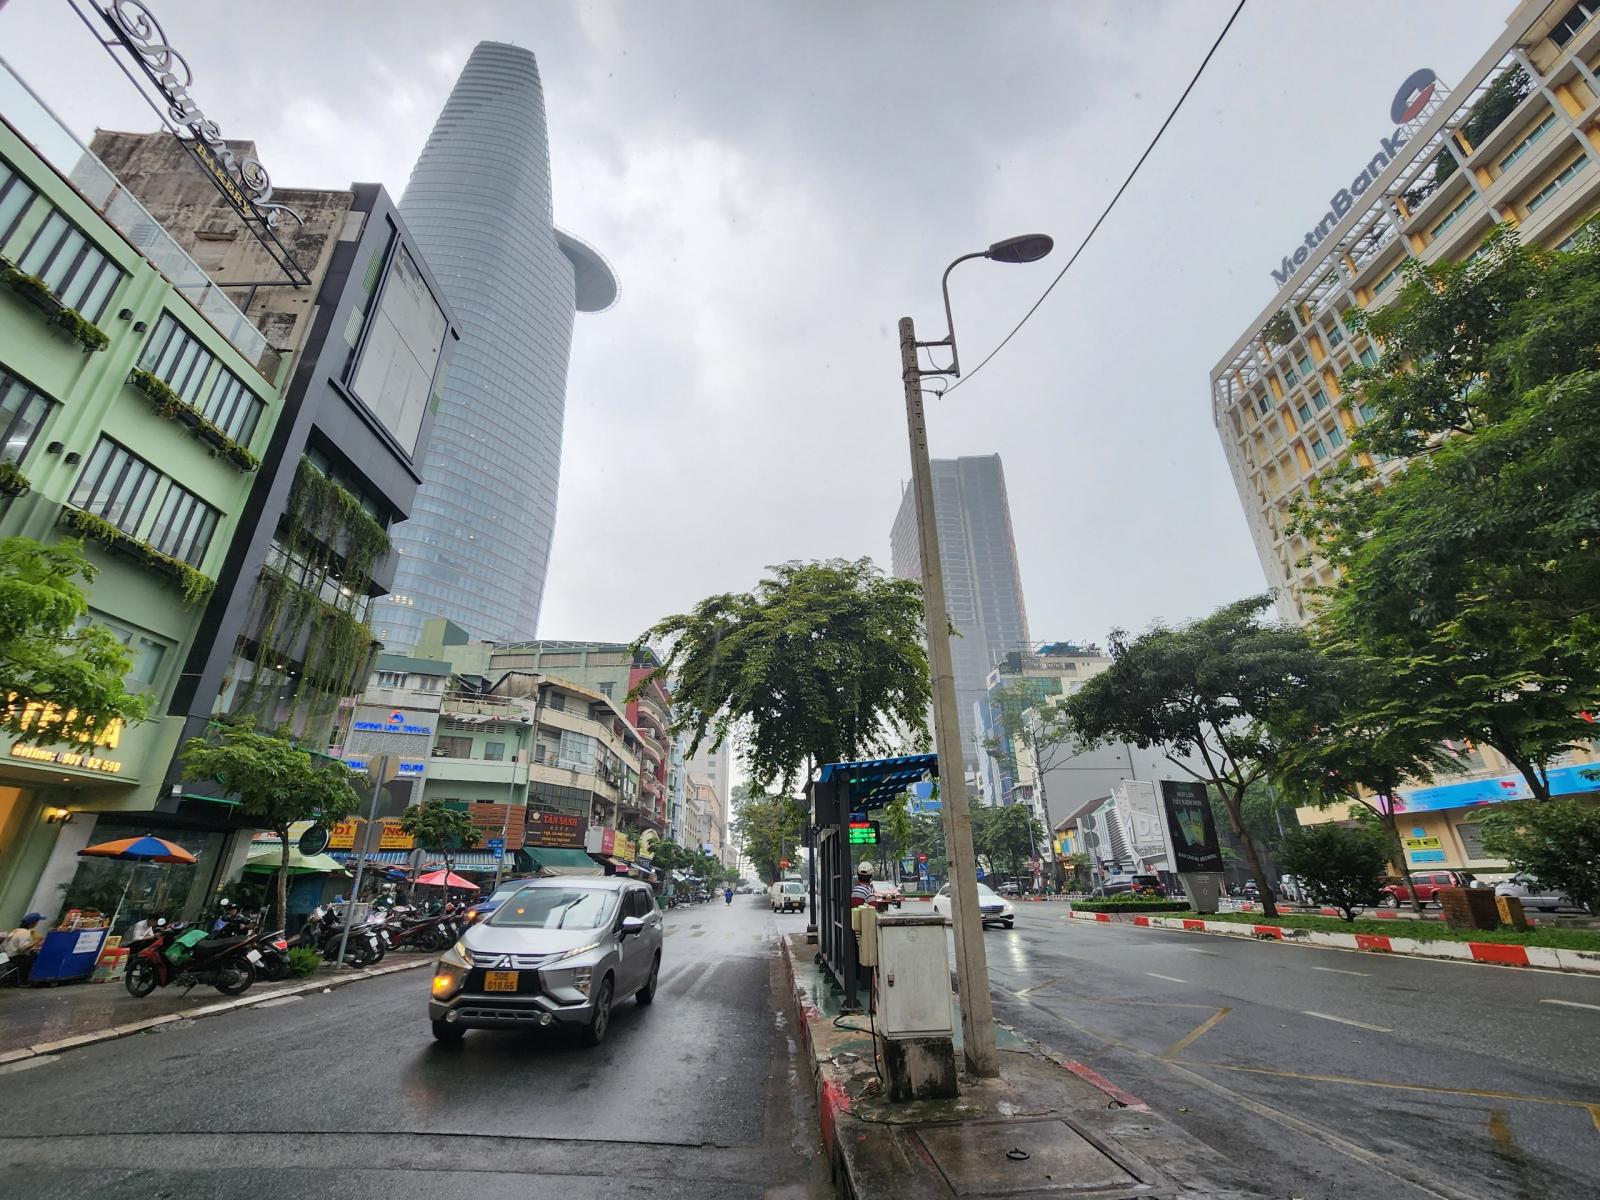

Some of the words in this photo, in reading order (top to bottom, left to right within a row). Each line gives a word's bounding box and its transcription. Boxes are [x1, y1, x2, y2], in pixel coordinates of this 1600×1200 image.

[196, 142, 252, 215] BAKERY
[1270, 127, 1409, 284] VietinBank
[56, 752, 82, 767] 0901
[82, 757, 101, 769] 862
[102, 760, 121, 773] 599
[400, 763, 424, 772] TOURS
